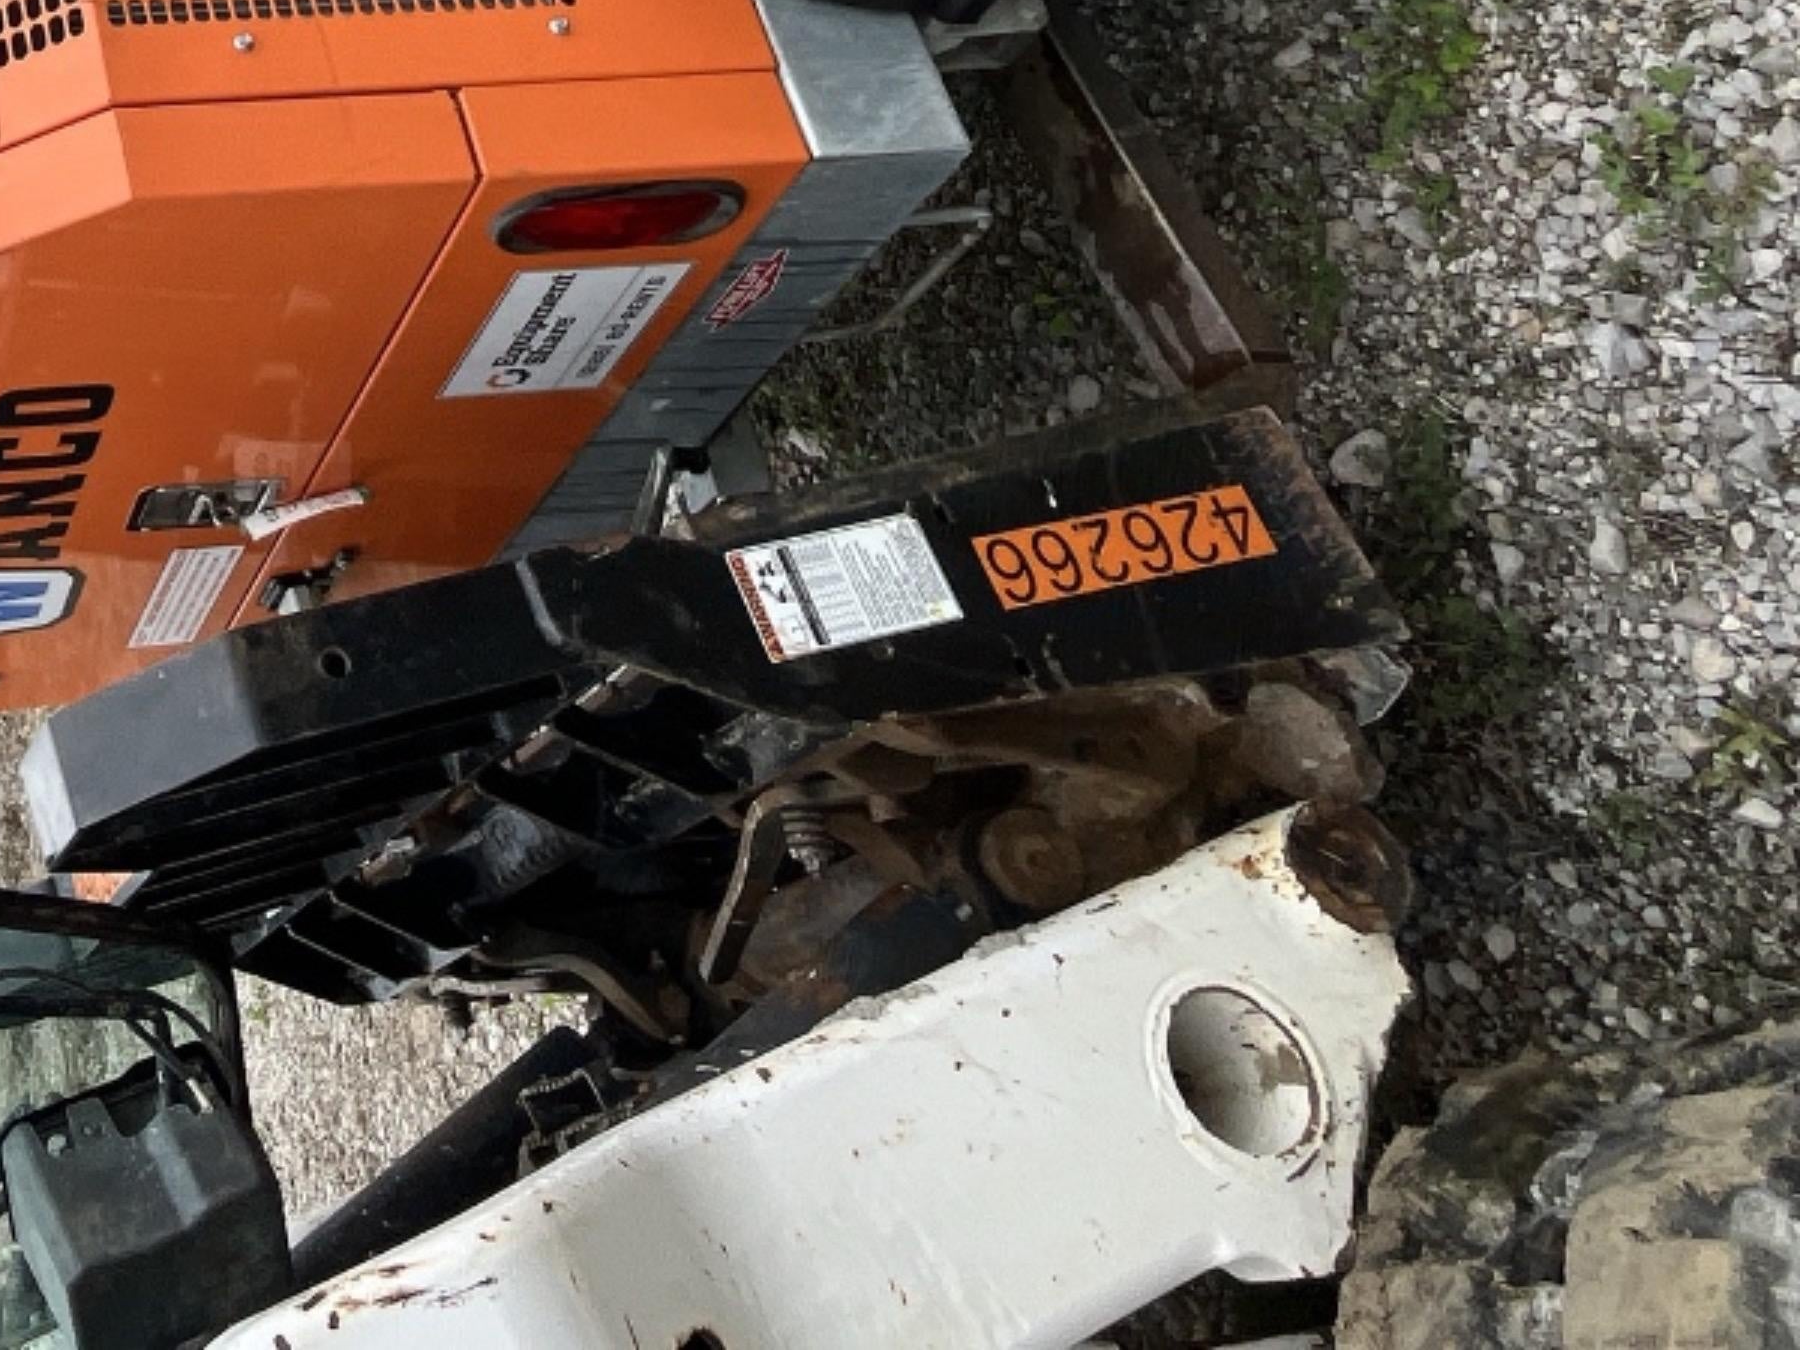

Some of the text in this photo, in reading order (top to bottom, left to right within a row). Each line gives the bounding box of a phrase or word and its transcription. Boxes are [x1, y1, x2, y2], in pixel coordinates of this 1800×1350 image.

[491, 273, 577, 367] Equipment
[522, 316, 577, 365] Share
[986, 494, 1250, 603] 426266
